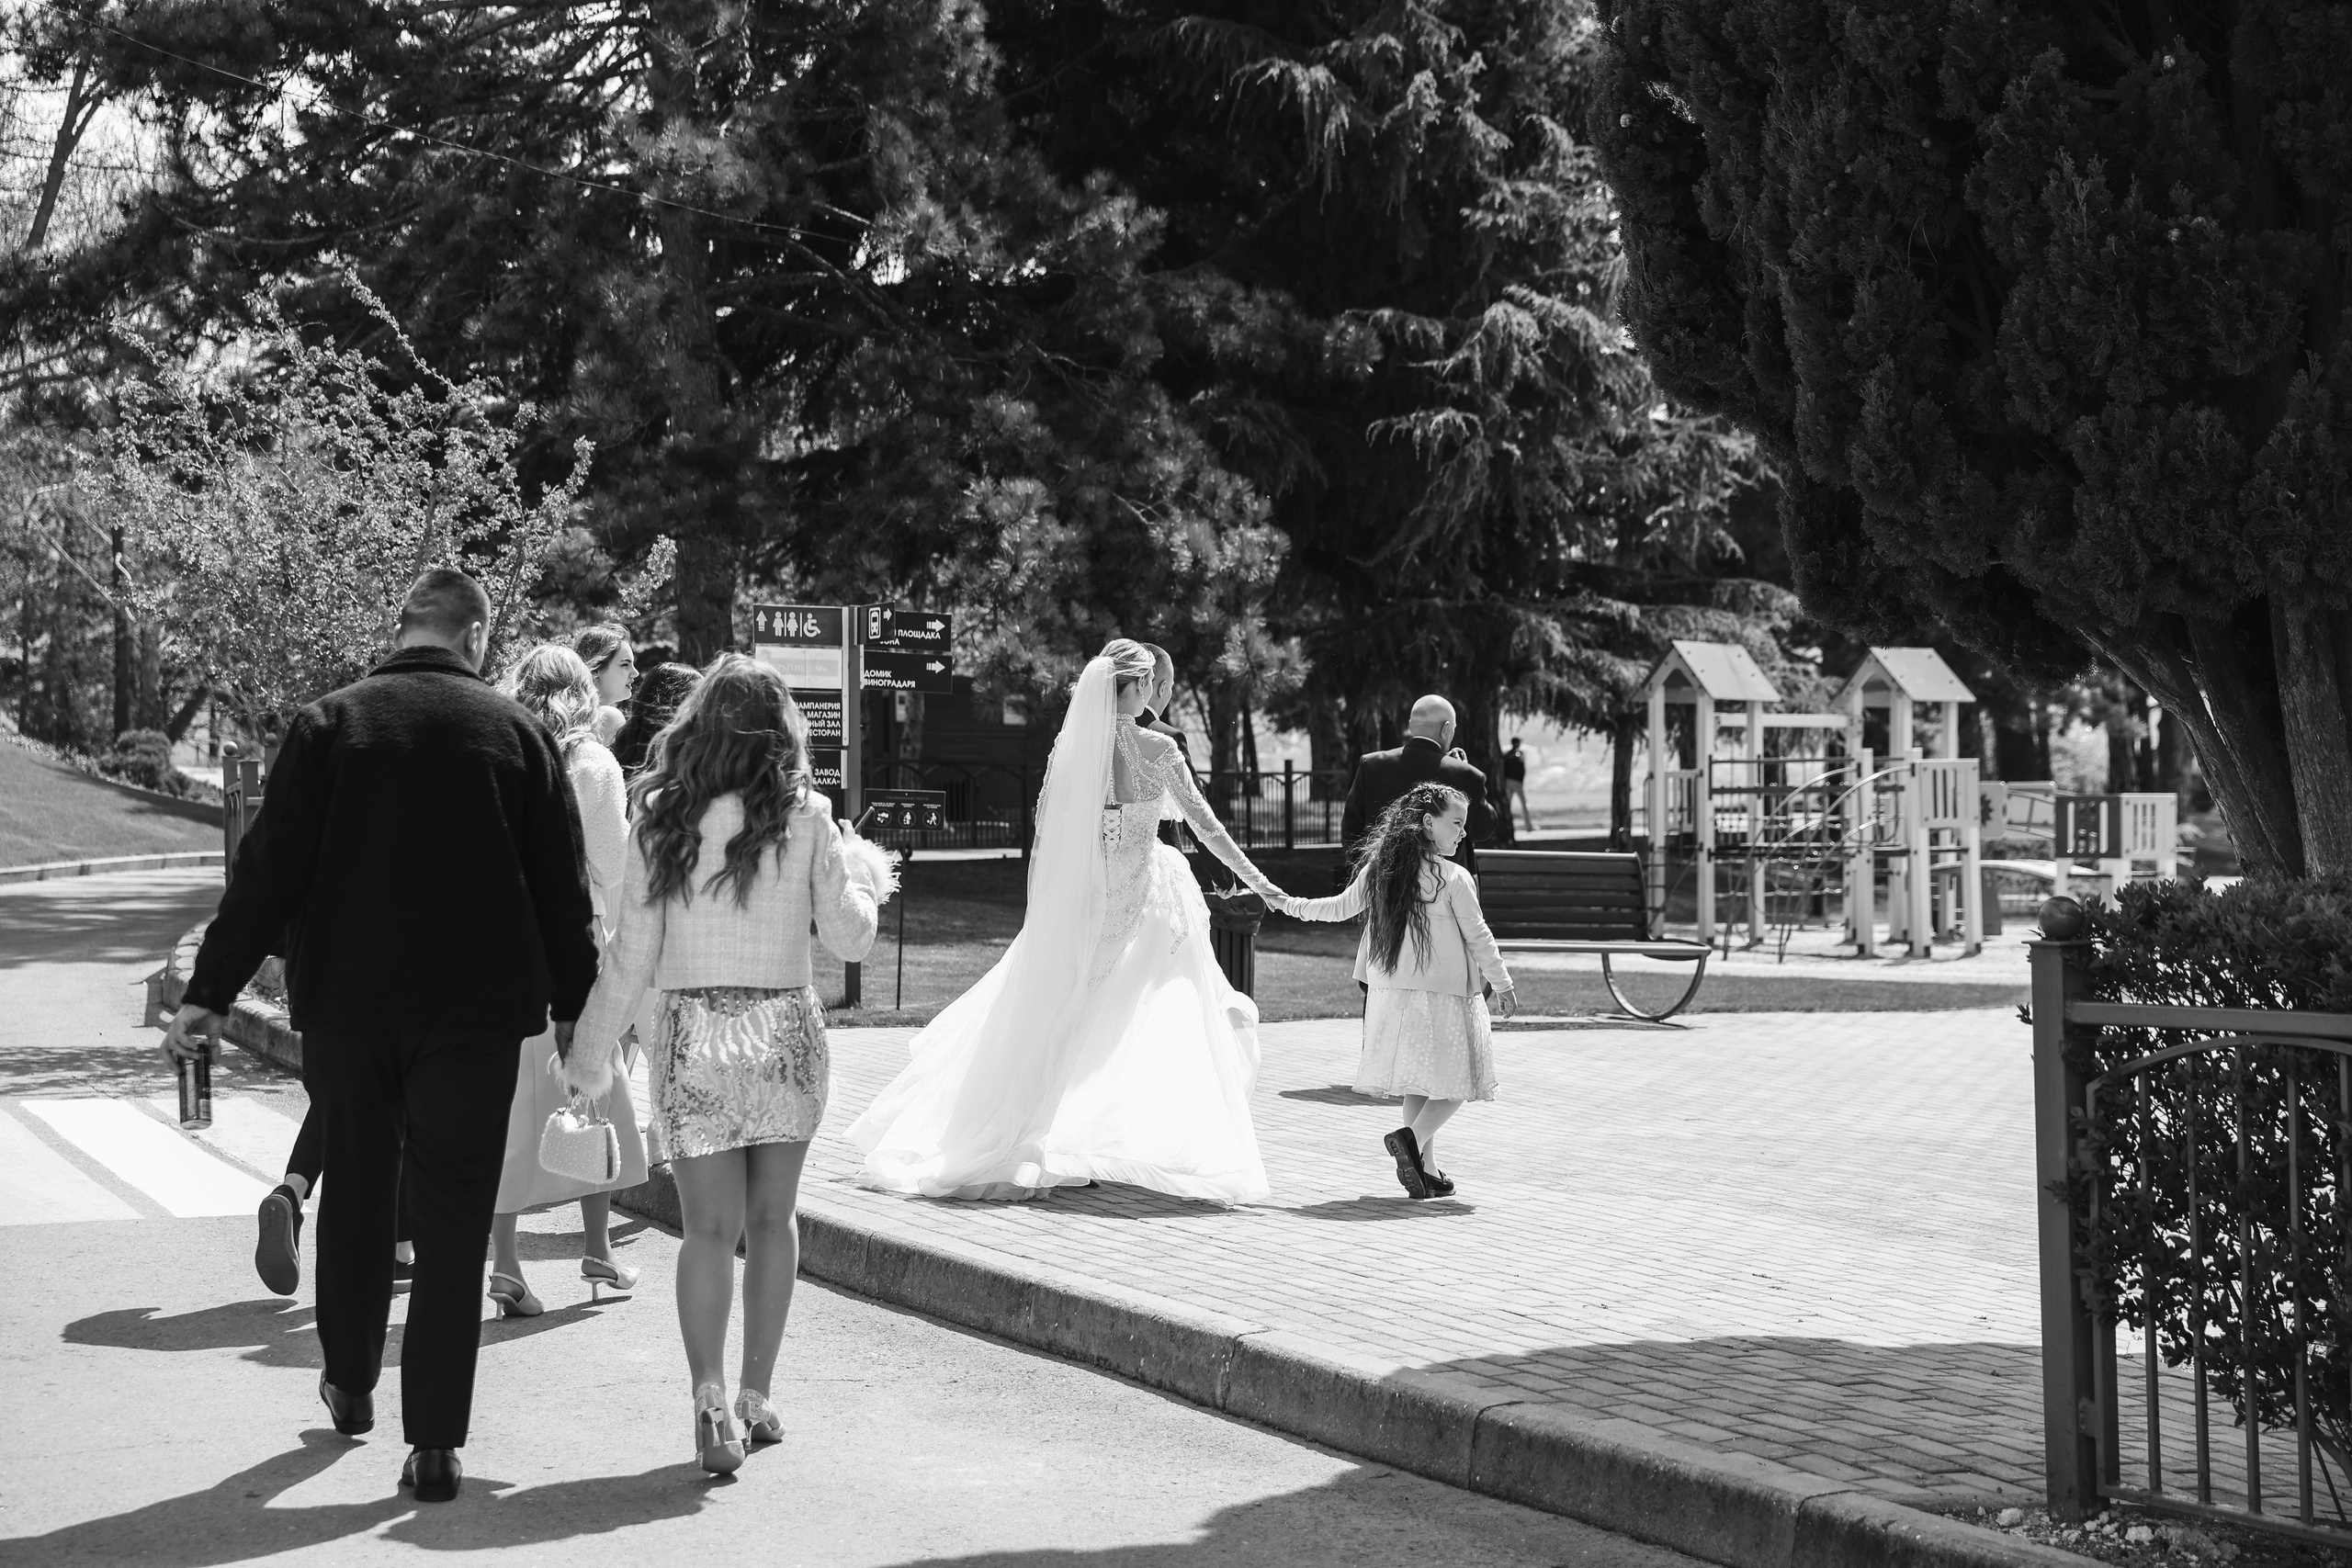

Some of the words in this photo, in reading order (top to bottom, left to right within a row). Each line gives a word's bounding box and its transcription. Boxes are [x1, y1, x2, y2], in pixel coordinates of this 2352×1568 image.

[898, 628, 941, 640] ПЛОЩАДКА
[864, 669, 892, 678] ДОМИК
[864, 678, 916, 688] ВИНОГРАДАРЯ
[807, 711, 841, 719] МАГАЗИН
[809, 719, 826, 728] НЫЙ
[808, 728, 841, 737] ЕСТОРАН
[814, 768, 841, 777] ЗАВОД
